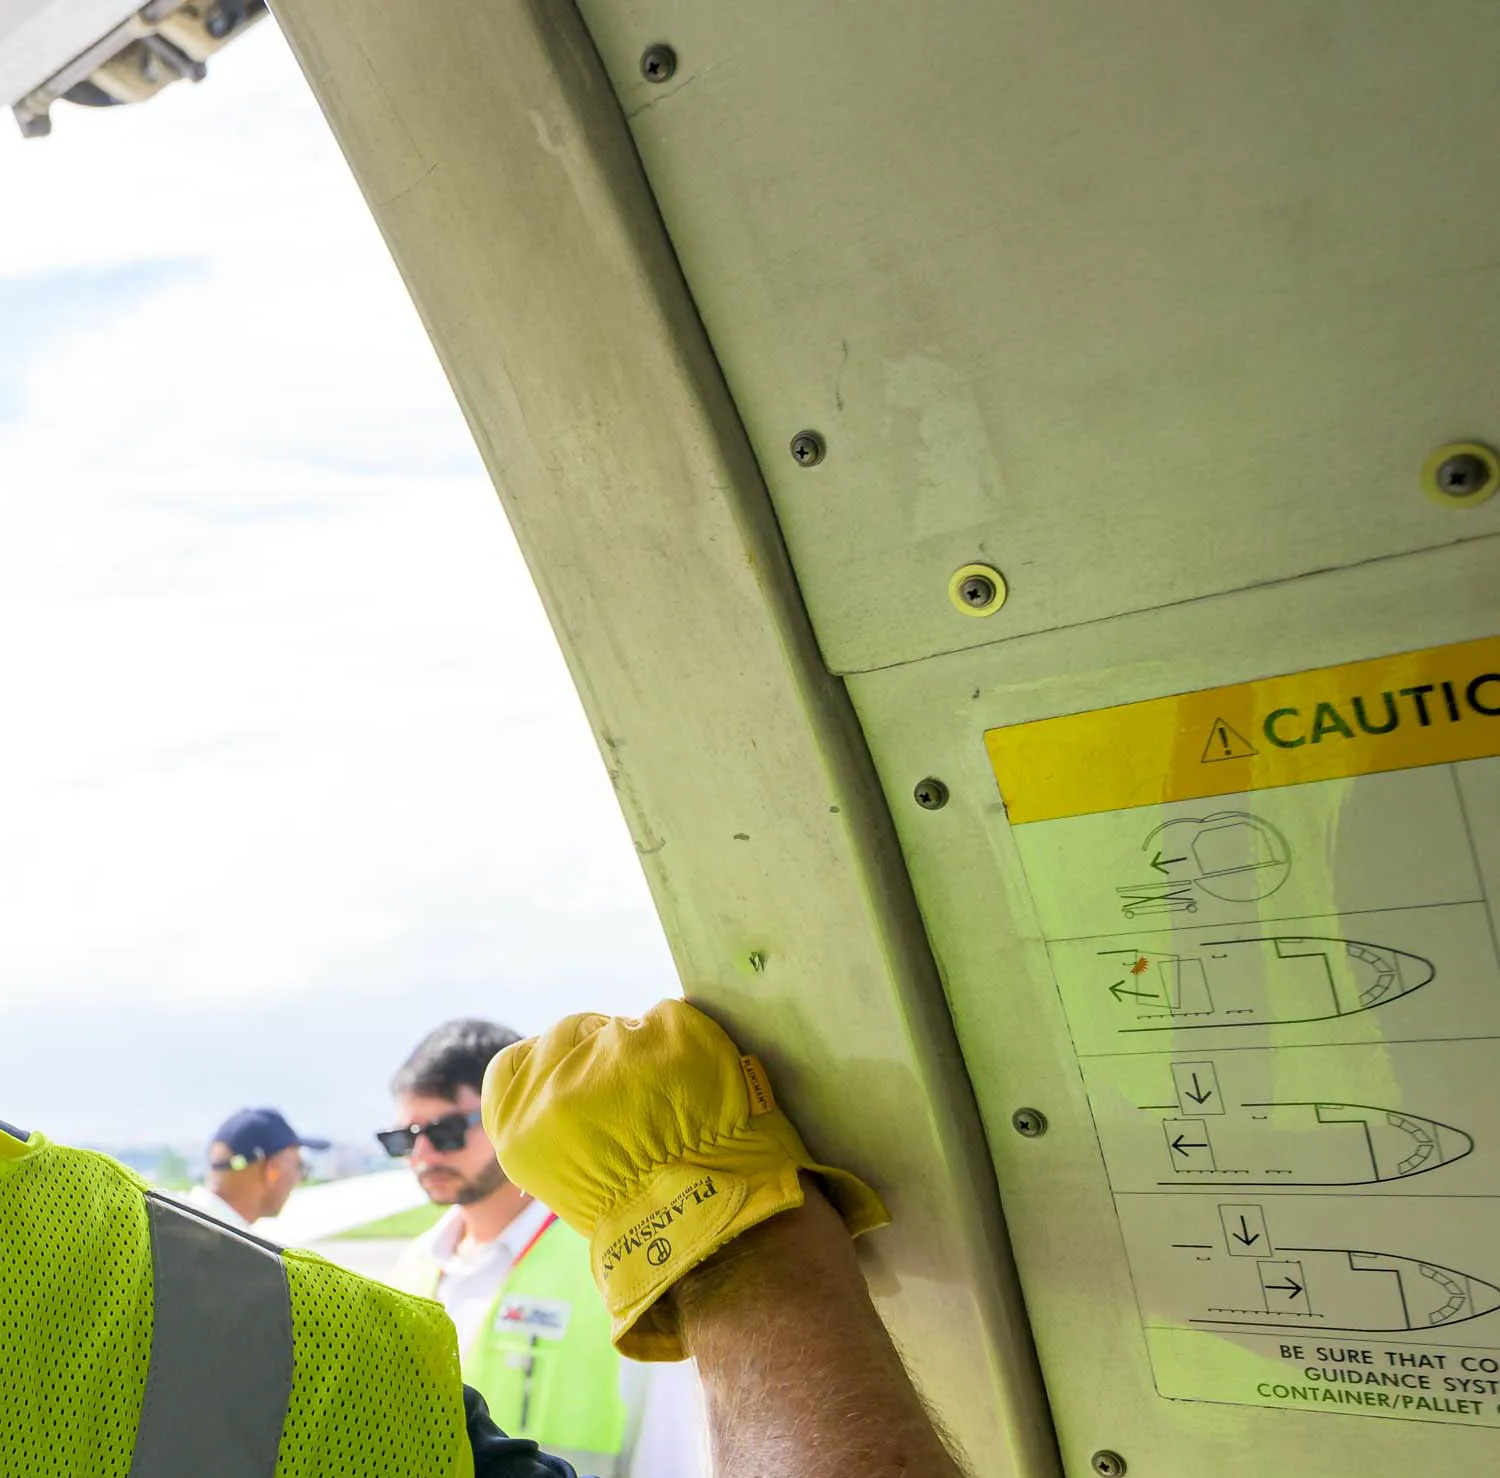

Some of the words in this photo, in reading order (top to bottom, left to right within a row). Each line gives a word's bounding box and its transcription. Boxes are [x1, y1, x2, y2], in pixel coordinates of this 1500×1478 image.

[1279, 1344, 1305, 1360] BE
[1315, 1347, 1374, 1365] SURE
[1385, 1351, 1447, 1370] THAT
[1460, 1357, 1499, 1374] CO
[1304, 1366, 1431, 1390] GUIDANCE
[1256, 1382, 1484, 1416] CONTAINER/PALLET
